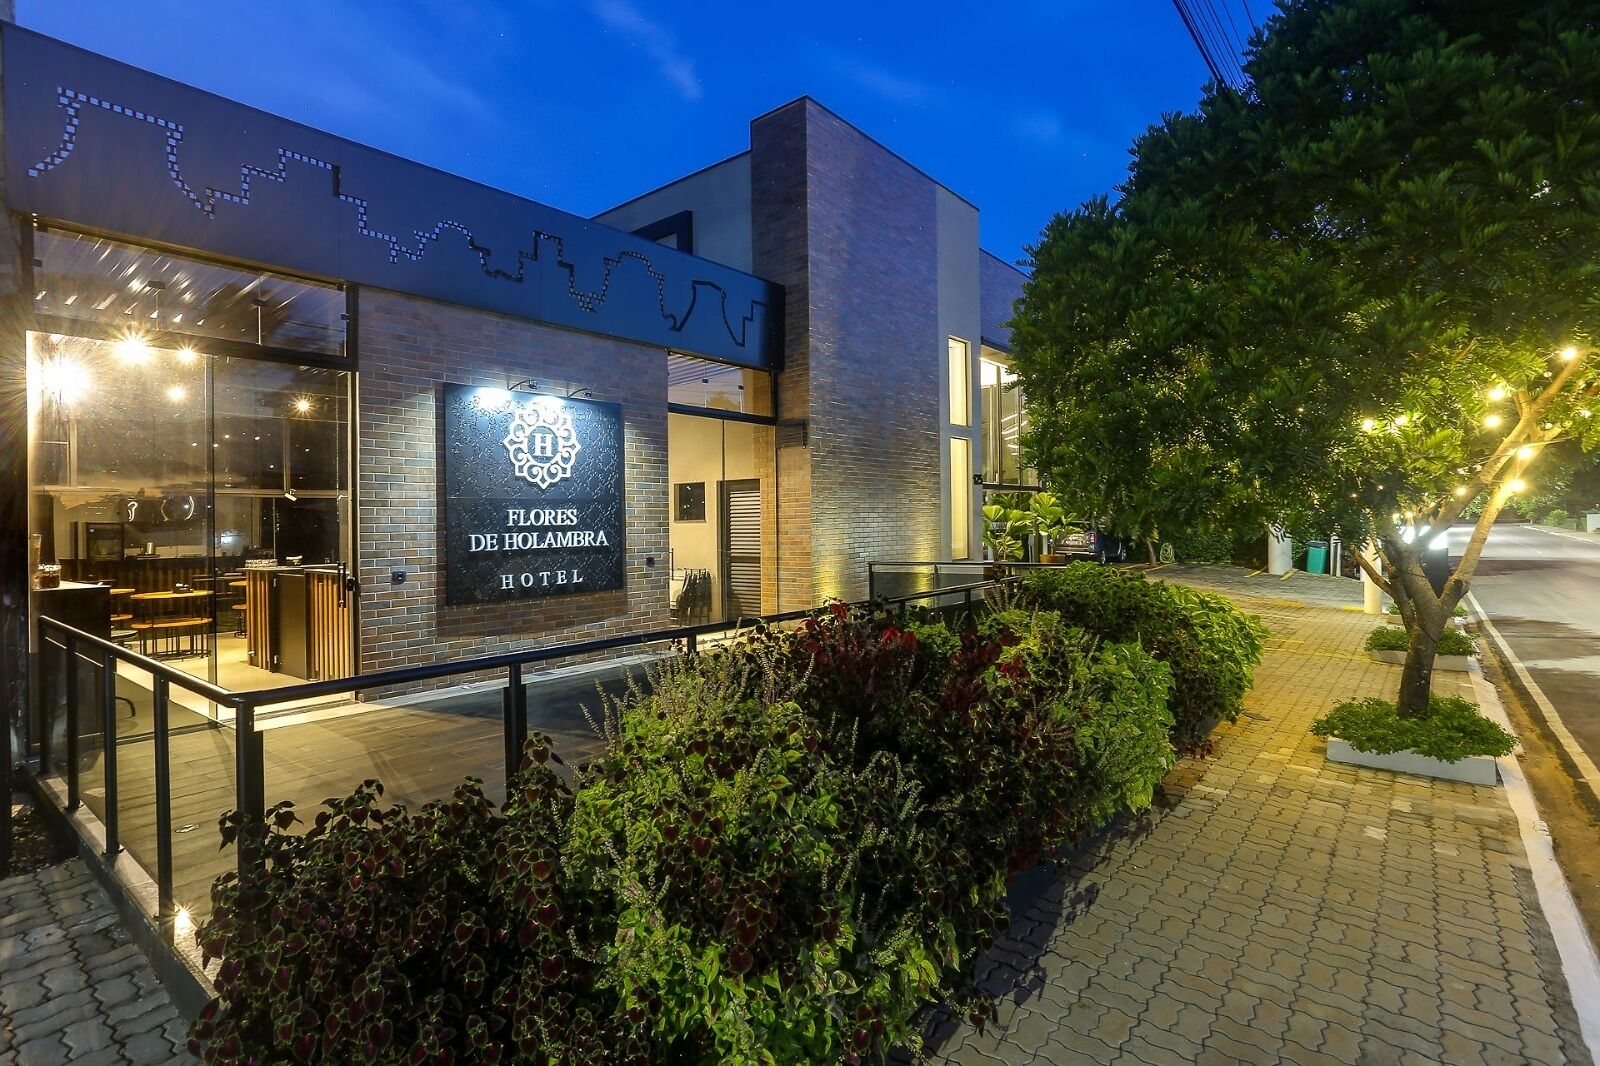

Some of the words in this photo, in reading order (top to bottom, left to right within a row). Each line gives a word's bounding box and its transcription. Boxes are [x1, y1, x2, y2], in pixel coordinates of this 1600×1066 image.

[534, 433, 554, 457] H
[507, 509, 577, 526] FLORES
[469, 534, 498, 552] DE
[503, 531, 609, 550] HOLAMBRA
[501, 569, 583, 589] HOTEL
